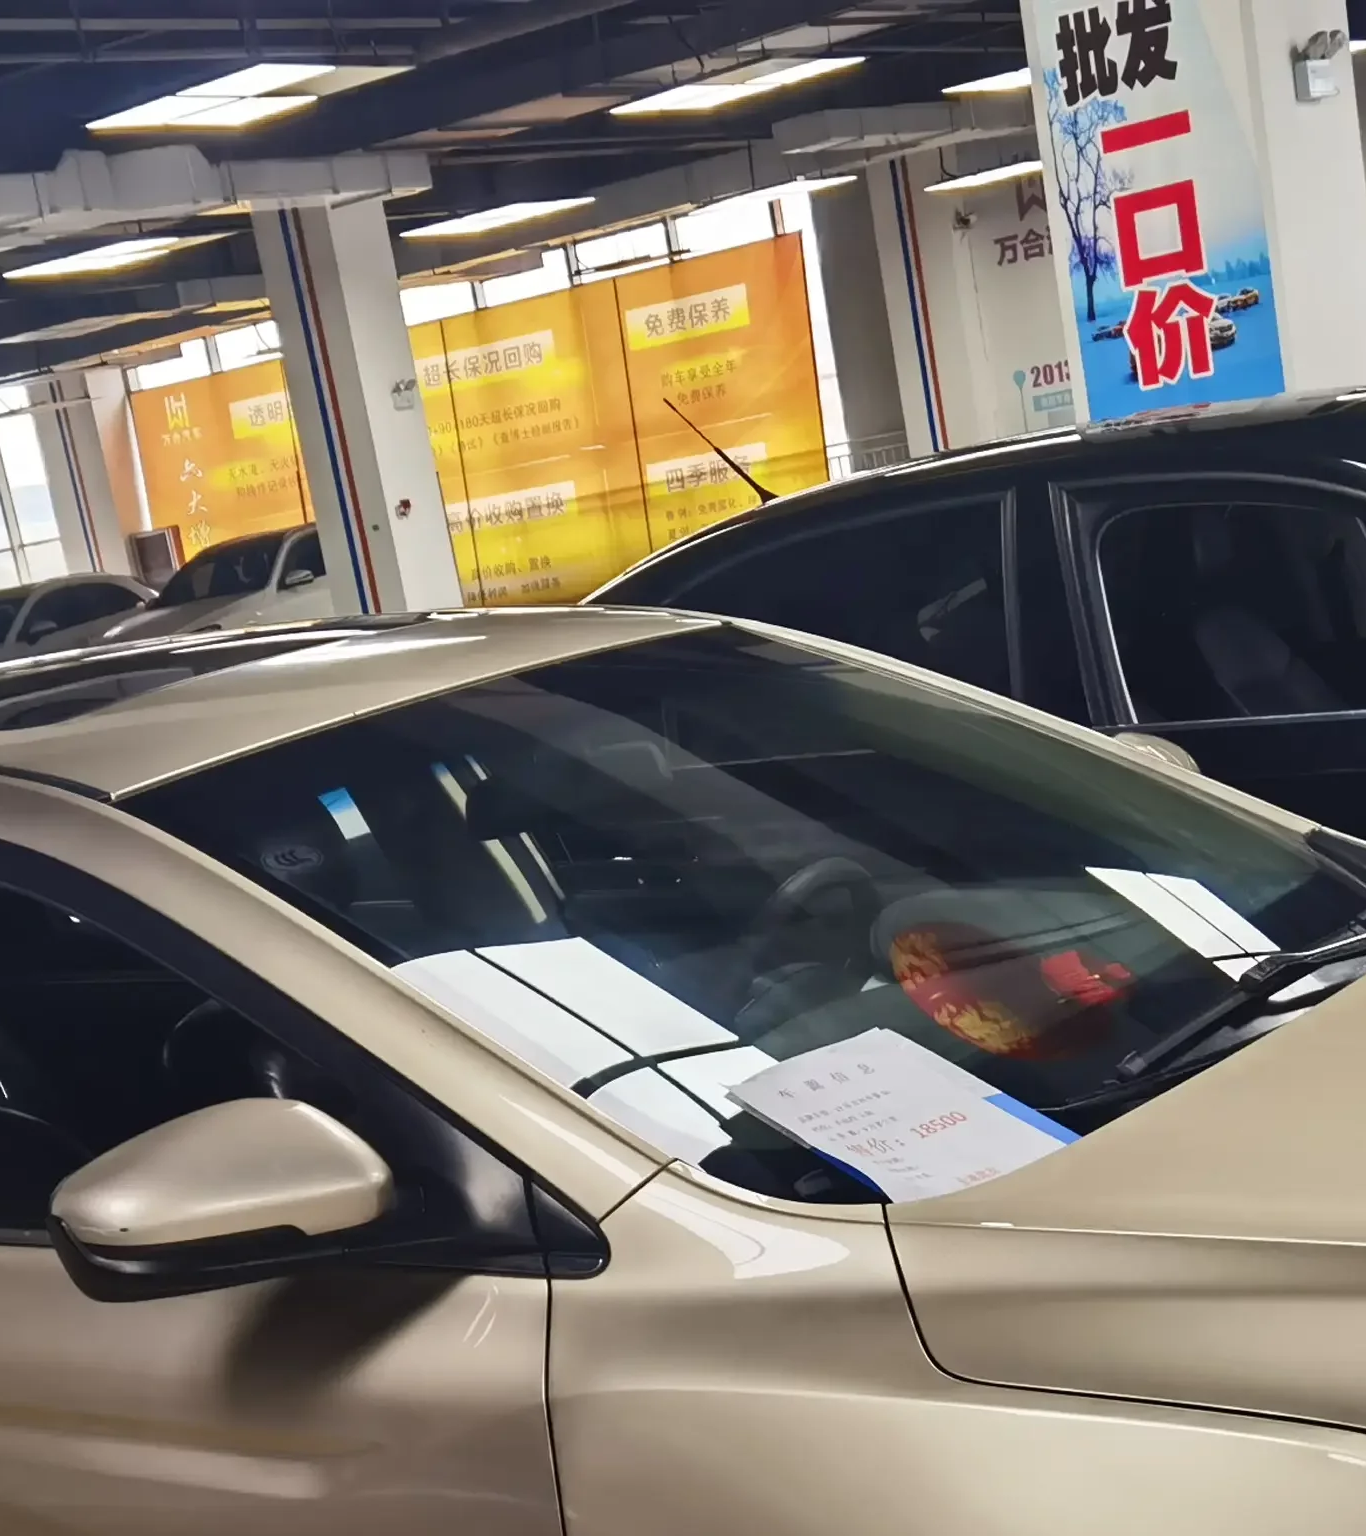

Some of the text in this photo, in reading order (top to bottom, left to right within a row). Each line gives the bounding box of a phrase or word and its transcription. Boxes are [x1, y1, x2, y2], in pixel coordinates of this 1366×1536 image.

[1055, 0, 1178, 107] 批发
[1101, 109, 1217, 388] 一口价
[645, 296, 731, 338] 免费保养
[423, 341, 544, 388] 超长保况回购
[248, 400, 285, 427] 透明
[448, 491, 565, 533] 高价收购置换
[910, 1110, 968, 1139] 18500
